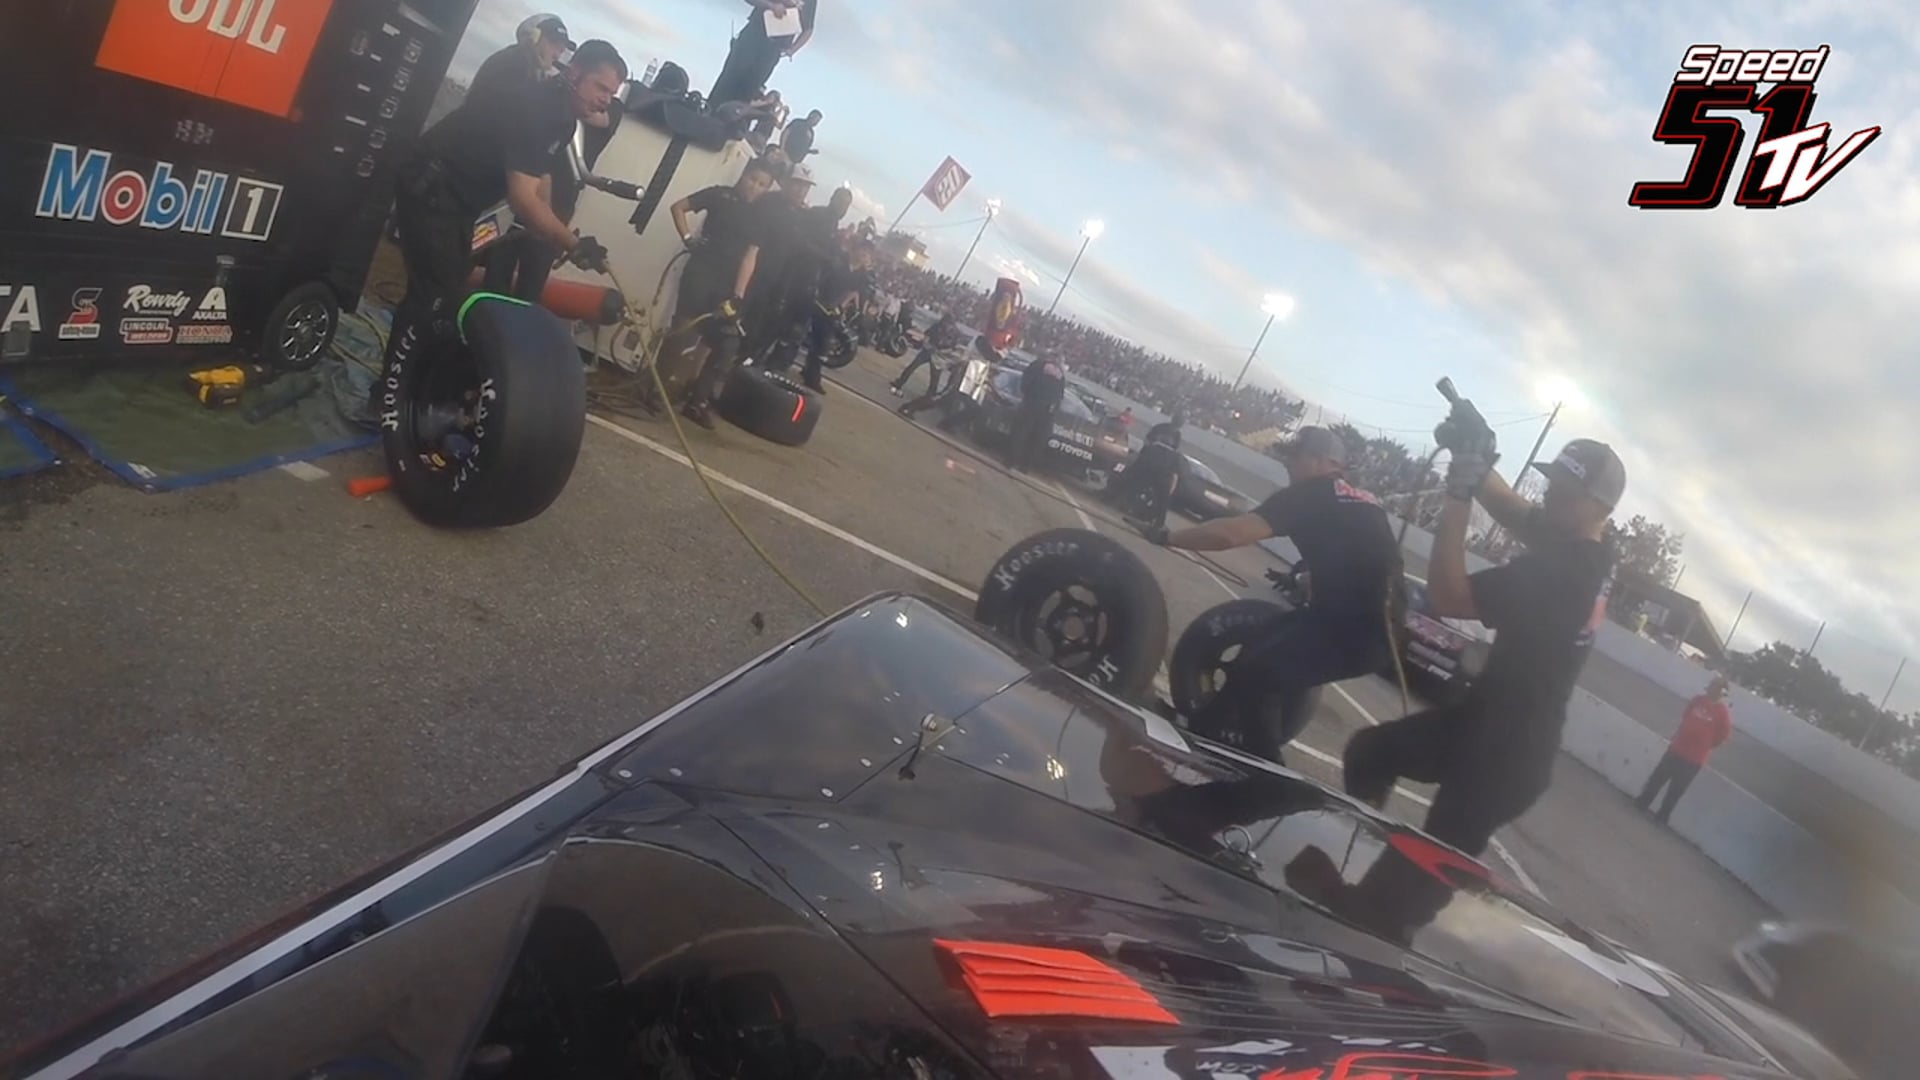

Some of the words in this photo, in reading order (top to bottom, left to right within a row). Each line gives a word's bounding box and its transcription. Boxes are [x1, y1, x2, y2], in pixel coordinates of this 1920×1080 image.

[35, 143, 229, 234] Mobil
[0, 285, 41, 332] A
[123, 284, 192, 317] Rowdy
[192, 310, 228, 320] AXALTA
[123, 322, 167, 332] LINCOLN
[382, 325, 417, 432] Hoosier
[1060, 441, 1093, 461] TOYOTA
[994, 542, 1080, 591] Hoosier
